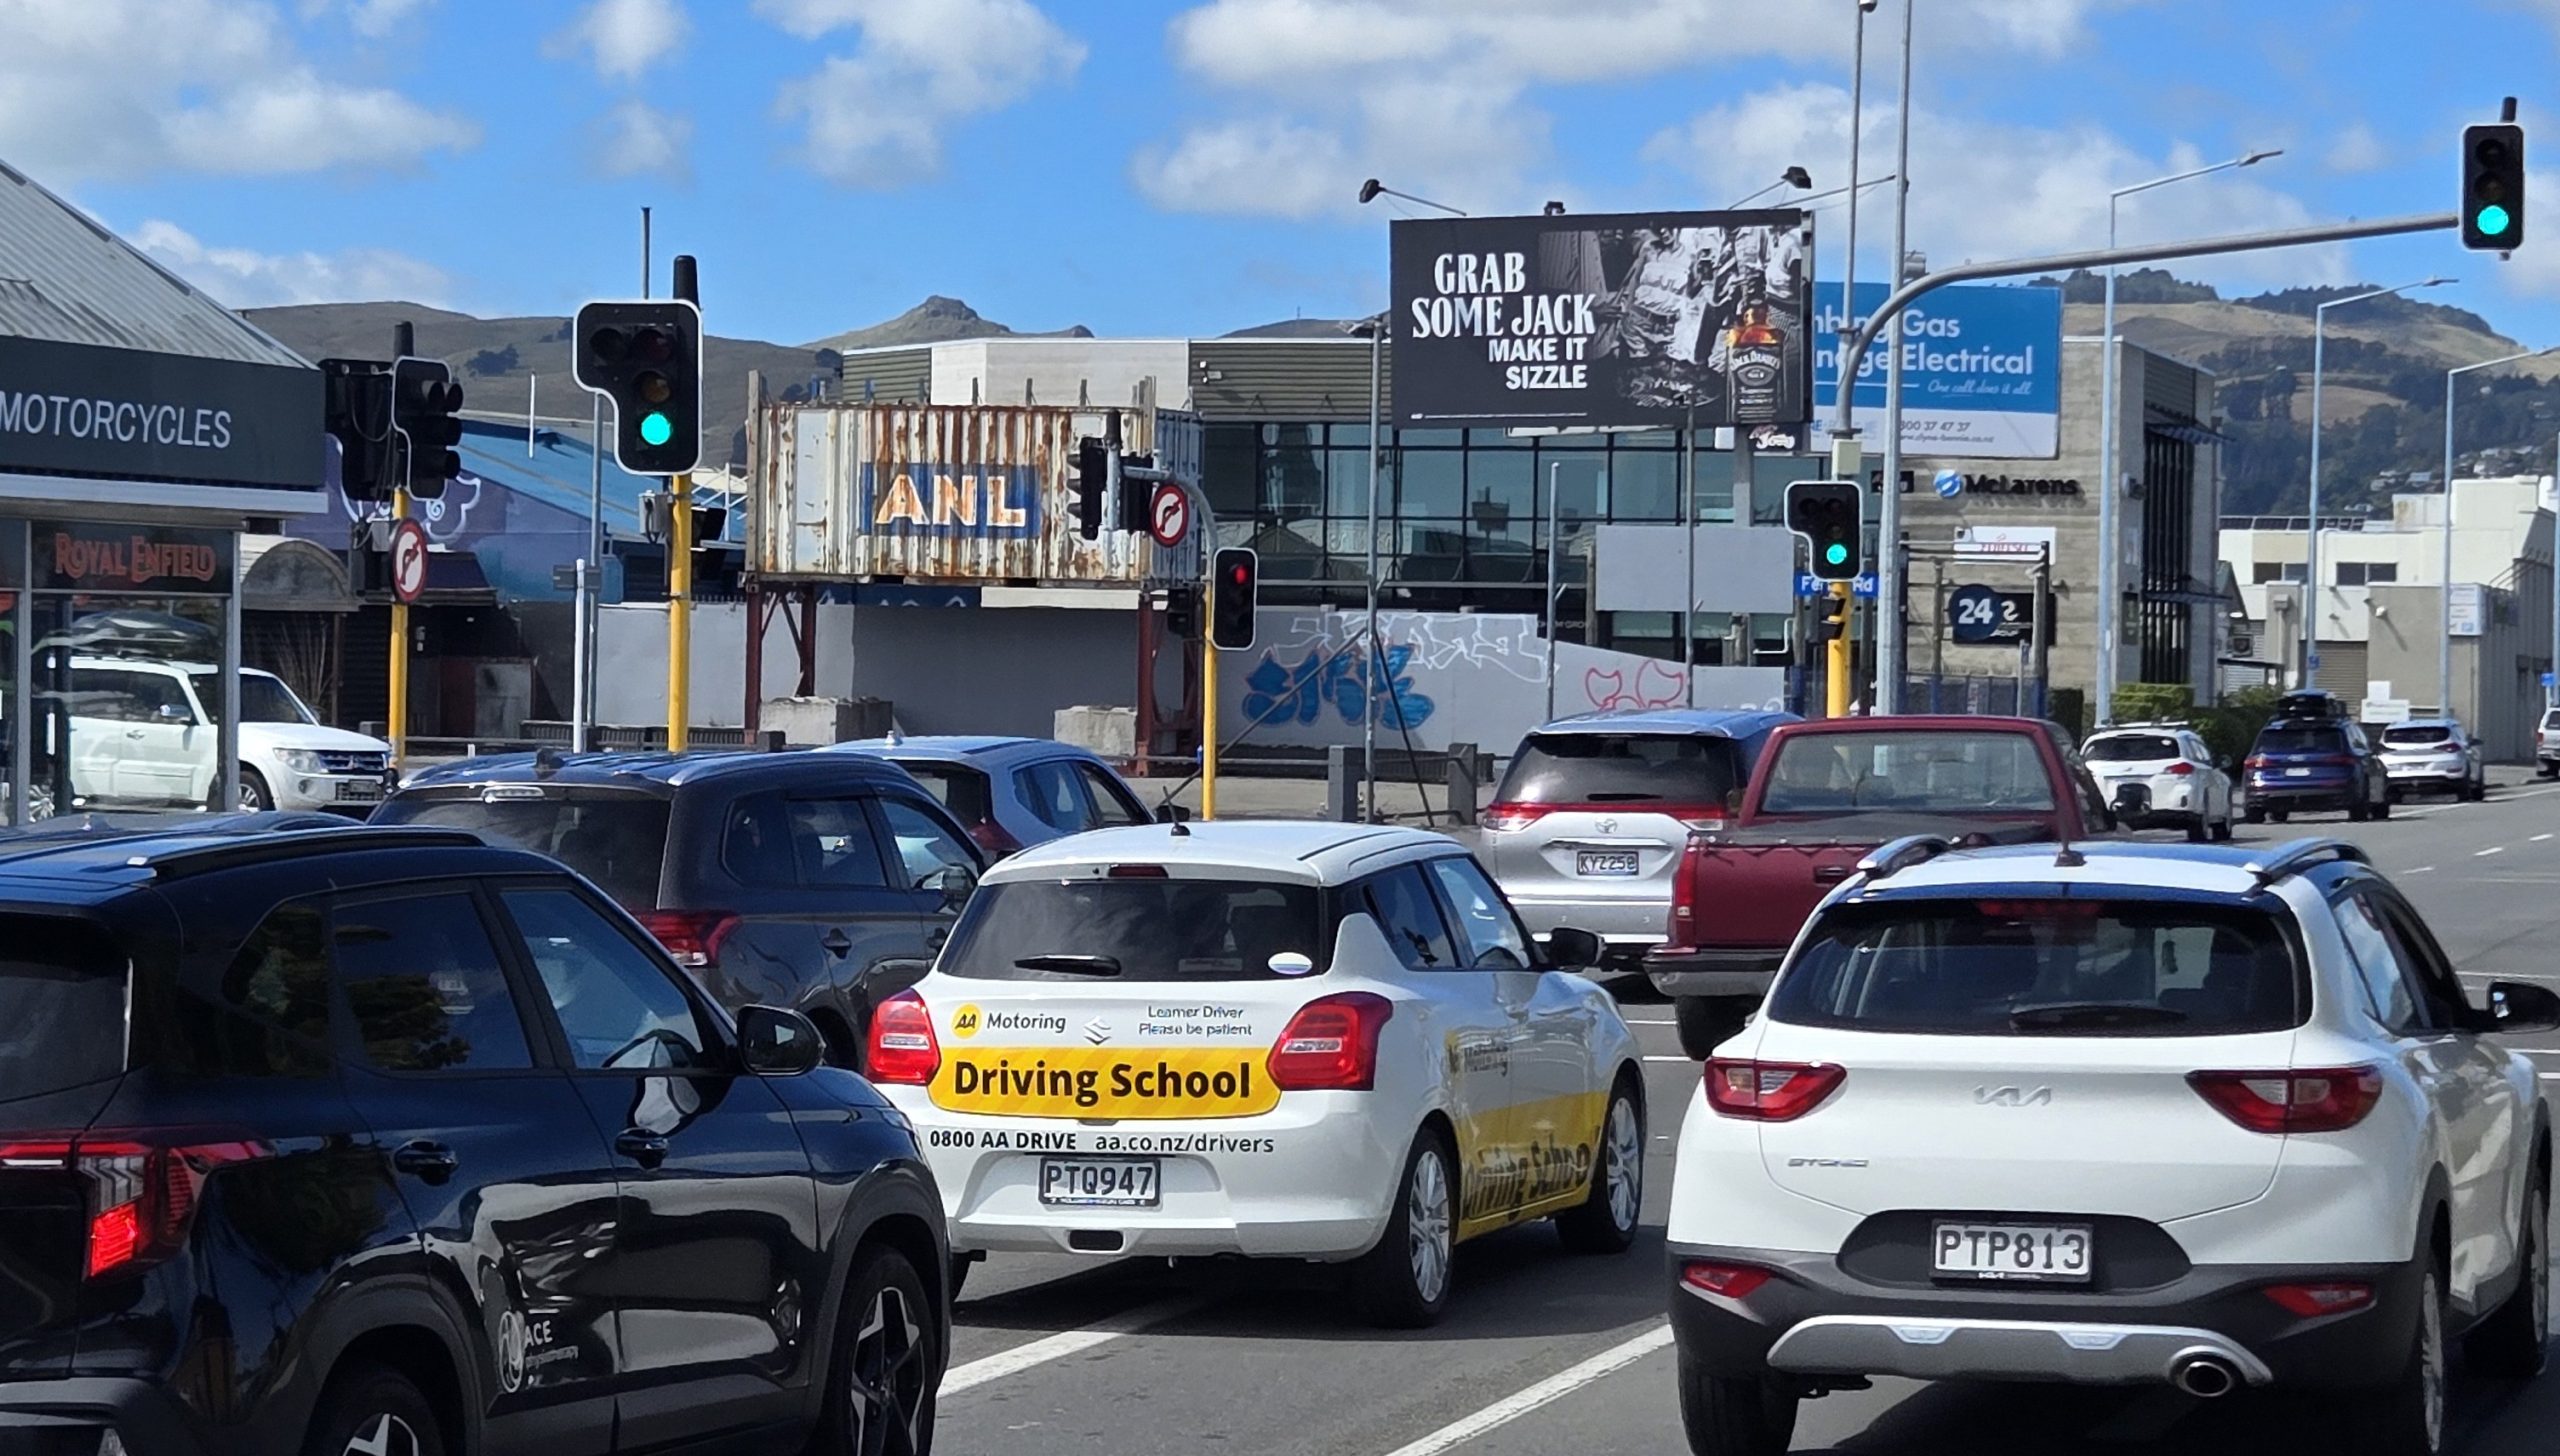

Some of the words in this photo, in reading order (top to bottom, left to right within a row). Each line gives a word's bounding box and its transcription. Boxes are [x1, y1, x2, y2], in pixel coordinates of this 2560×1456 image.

[1434, 252, 1526, 294] GRAB
[1411, 296, 1504, 338] SOME
[1511, 294, 1596, 336] JACK
[1902, 309, 1961, 338] Gas
[1488, 338, 1558, 362] MAKE
[1566, 337, 1588, 360] IT
[1901, 344, 2034, 375] Electrical
[1505, 365, 1588, 390] SIZZLE
[0, 390, 232, 449] MOTORCYCLES
[1964, 474, 2079, 496] McLarens
[876, 474, 1026, 528] ANL
[55, 532, 128, 579] ROYAL
[131, 535, 217, 582] ENFIELD
[1852, 576, 1873, 593] Rd
[1958, 598, 1994, 625] 24
[954, 1014, 977, 1030] AA
[987, 1012, 1067, 1034] Motoring
[1148, 1005, 1200, 1018] Learner
[1203, 1005, 1244, 1018] Driver
[1139, 1023, 1183, 1035] Please
[1186, 1023, 1203, 1035] be
[1206, 1024, 1252, 1038] patient
[955, 1059, 1099, 1107] Driving
[1110, 1061, 1250, 1099] School
[930, 1130, 975, 1148] 0800
[980, 1131, 1009, 1149] AA
[1016, 1132, 1077, 1150] DRIVE
[1095, 1134, 1275, 1153] aa.co.nz/drivers
[1045, 1165, 1154, 1196] PTQ947
[1939, 1230, 2086, 1270] PTP813
[525, 1320, 553, 1346] ACE
